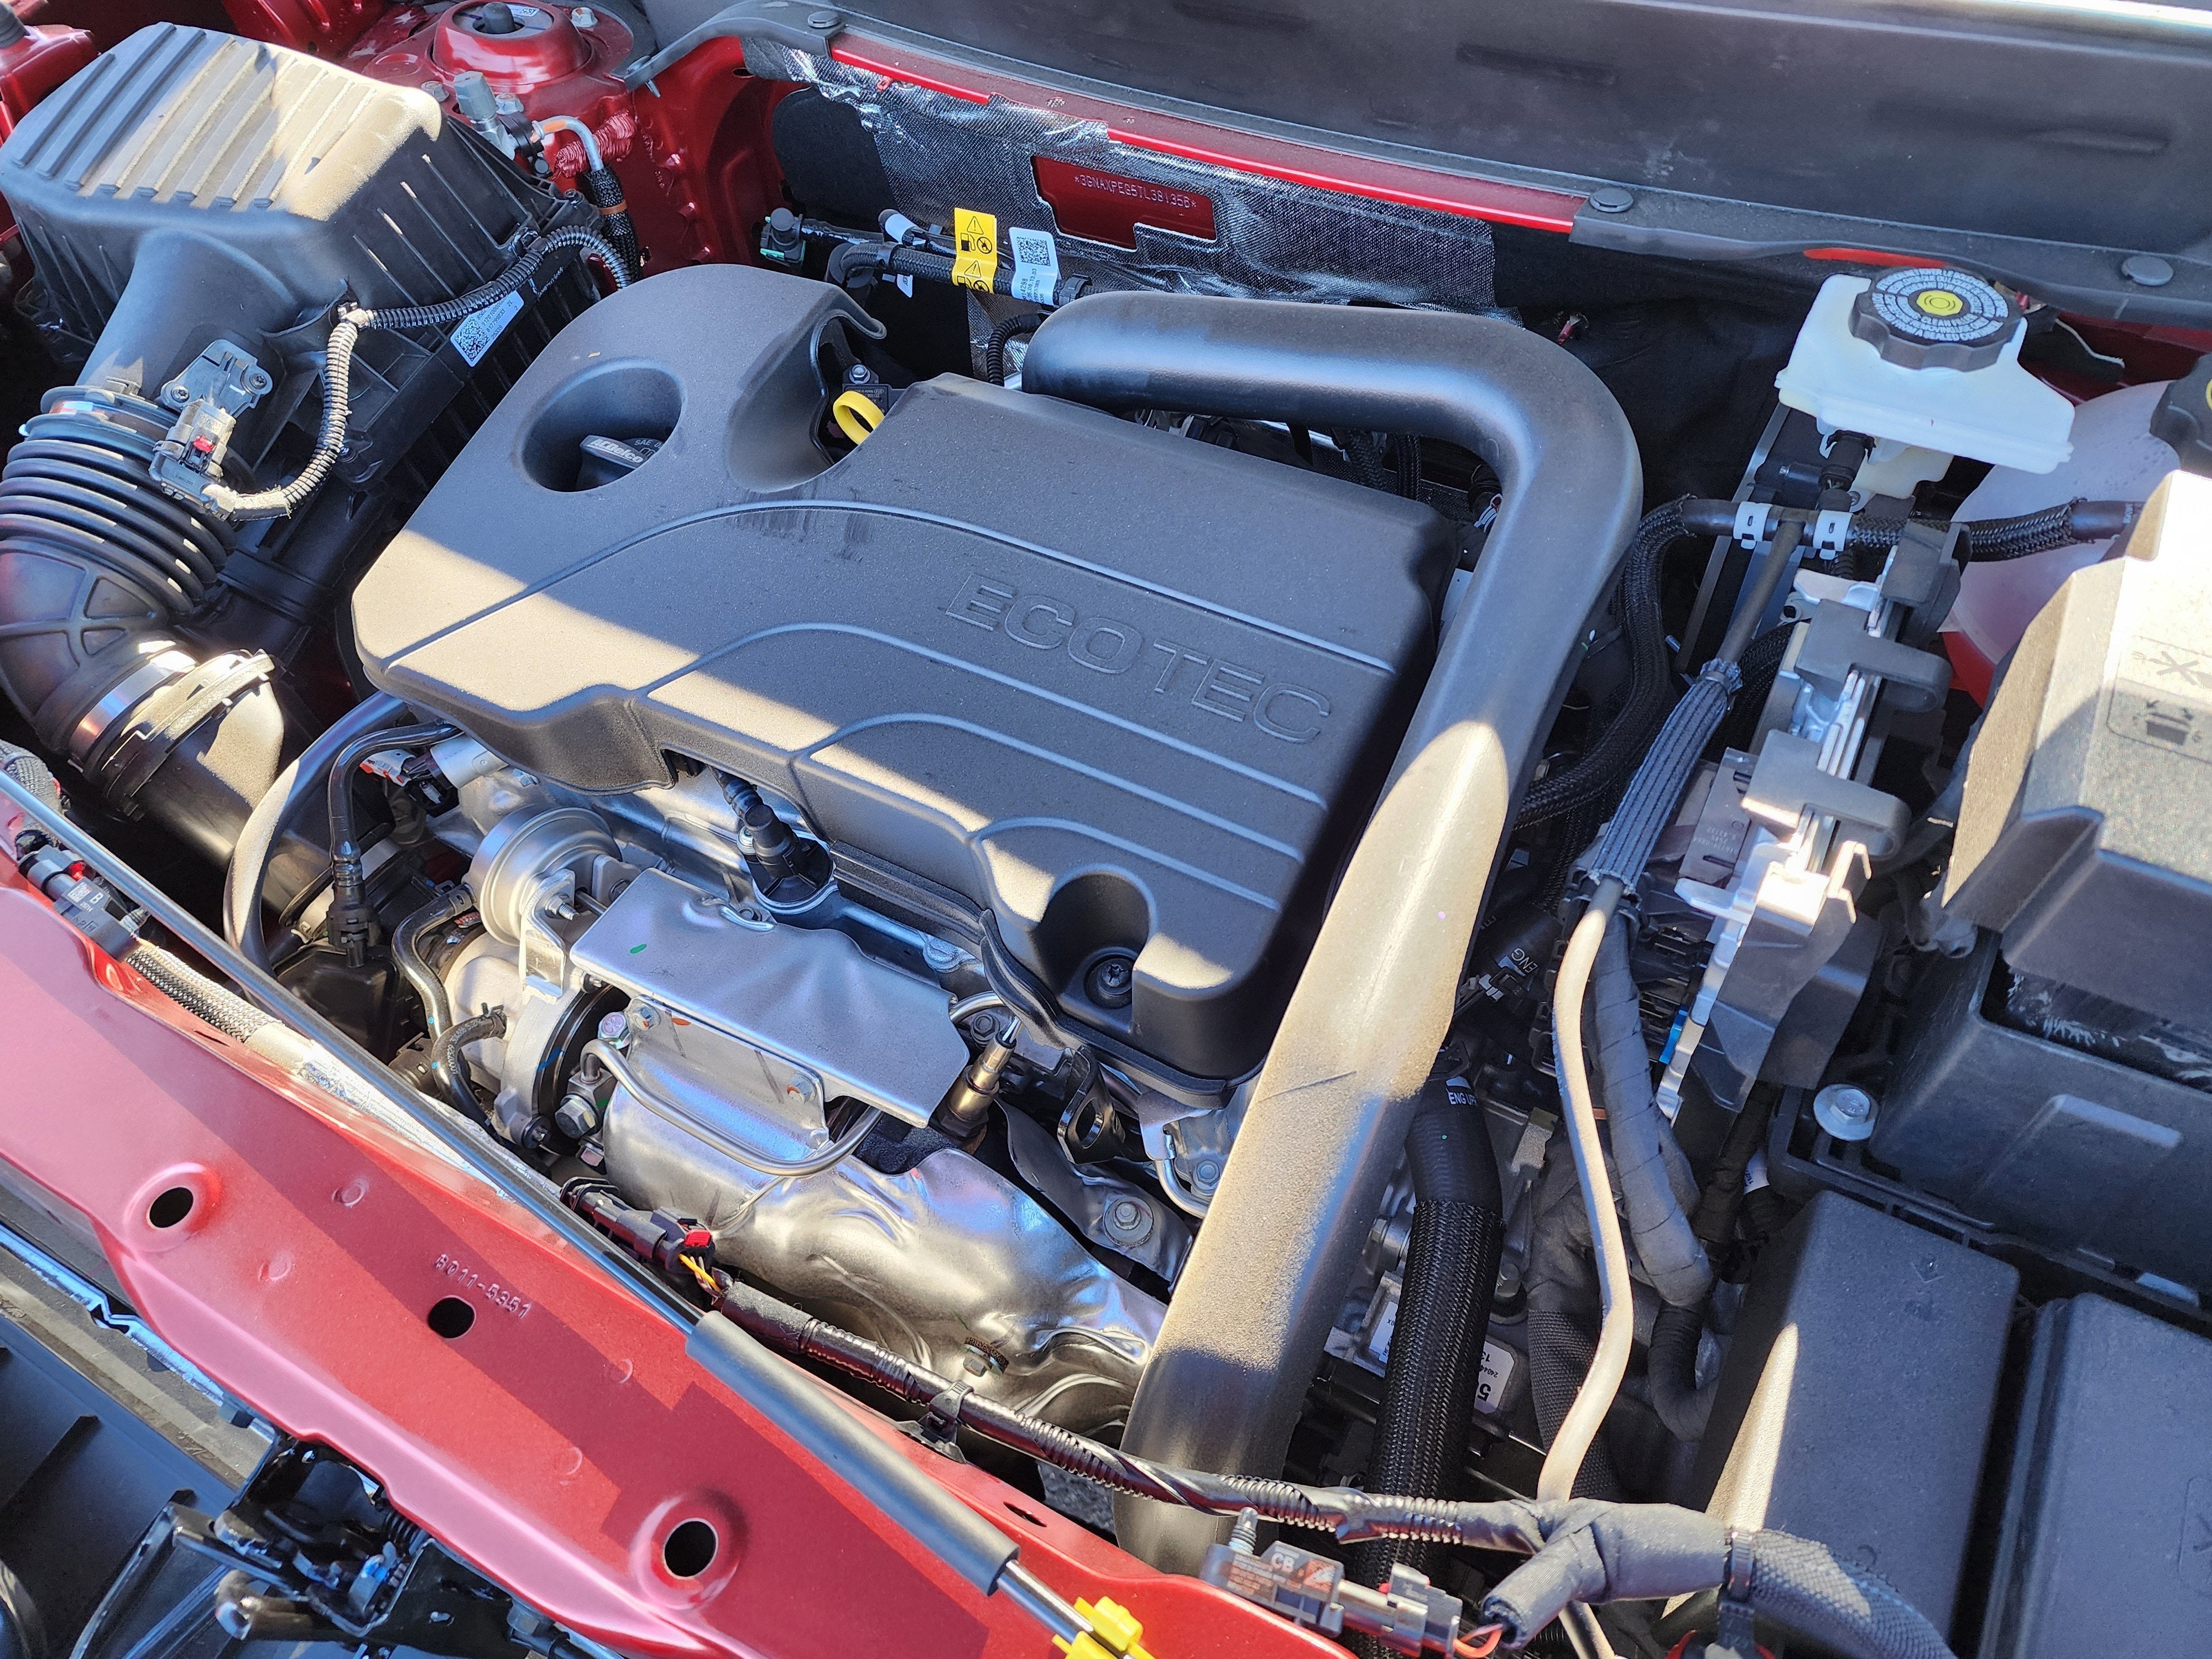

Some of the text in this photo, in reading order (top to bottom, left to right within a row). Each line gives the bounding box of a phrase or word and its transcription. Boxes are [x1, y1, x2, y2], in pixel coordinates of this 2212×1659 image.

[589, 439, 644, 463] ACDelco
[945, 573, 1331, 744] ECOTEC
[89, 892, 104, 904] B
[1511, 947, 1539, 974] ENG
[1448, 1091, 1467, 1107] ENG
[1271, 1552, 1295, 1573] CB
